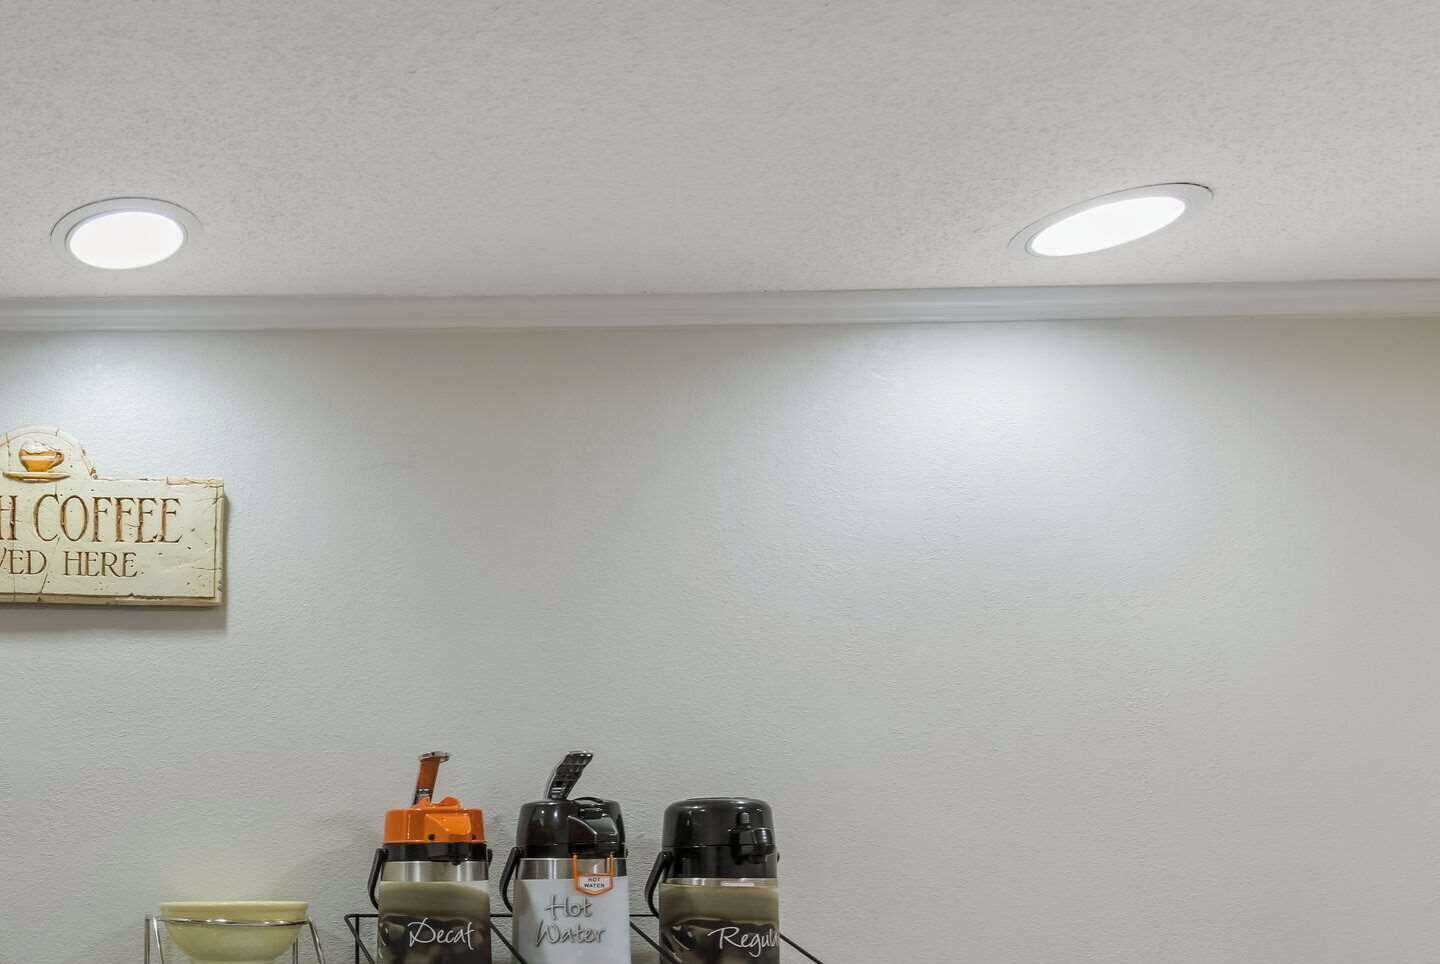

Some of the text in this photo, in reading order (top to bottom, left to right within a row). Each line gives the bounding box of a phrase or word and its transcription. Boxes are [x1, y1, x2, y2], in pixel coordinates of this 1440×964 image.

[32, 493, 184, 543] COFFEE
[63, 551, 138, 578] HERE
[544, 894, 593, 921] Hot
[535, 918, 606, 948] Water
